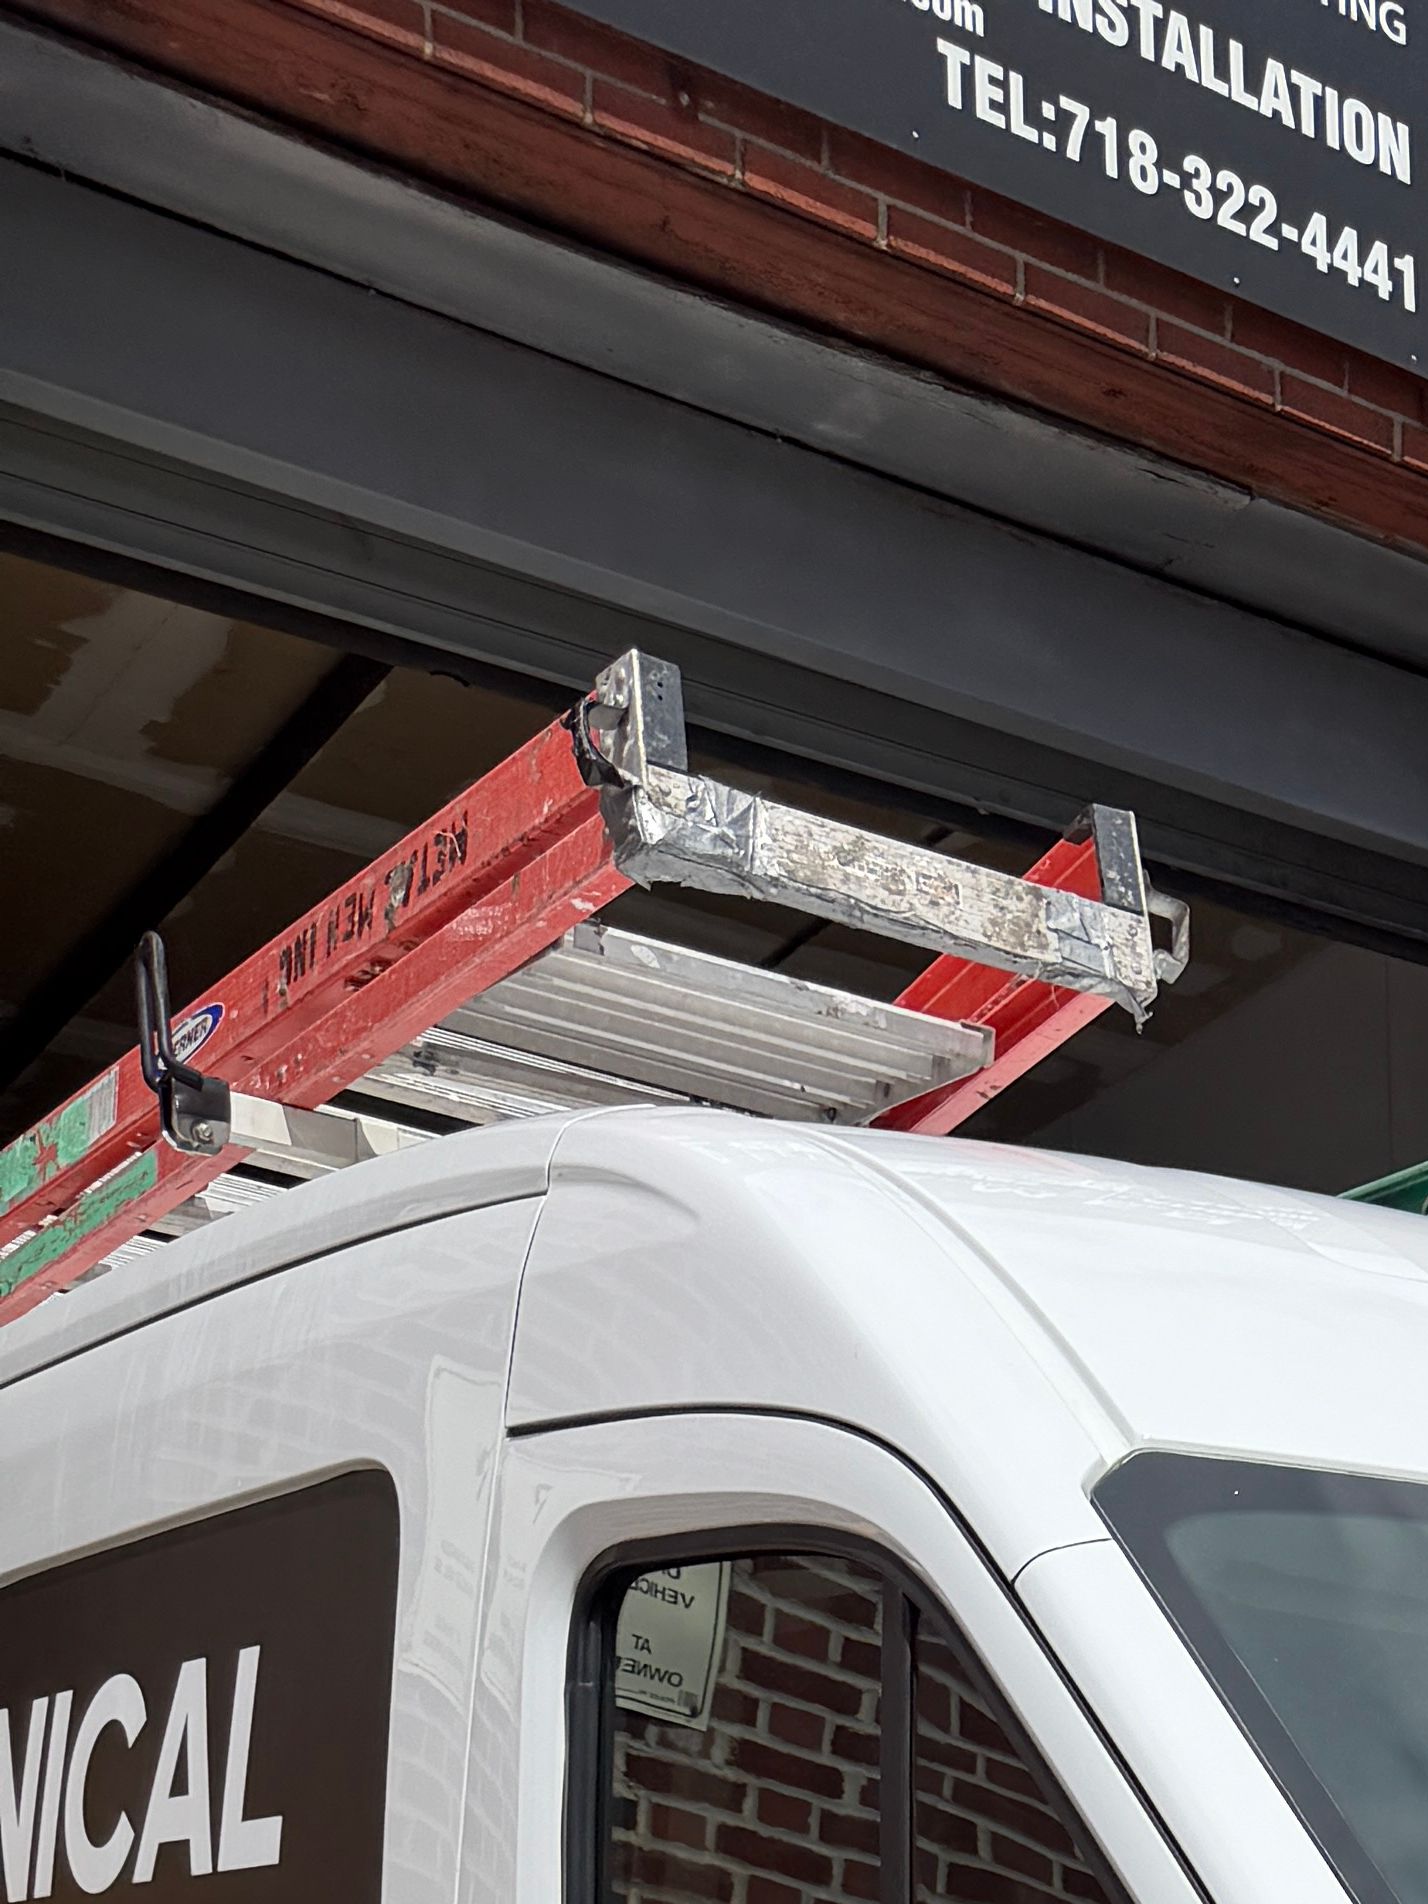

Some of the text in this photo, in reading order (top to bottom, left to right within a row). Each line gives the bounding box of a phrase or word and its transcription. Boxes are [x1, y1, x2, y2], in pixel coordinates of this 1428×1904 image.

[1321, 0, 1407, 46] NG
[1037, 0, 1412, 185] STALLATION
[936, 37, 1417, 313] TEL:718-322-4441
[172, 1015, 208, 1058] ERNER
